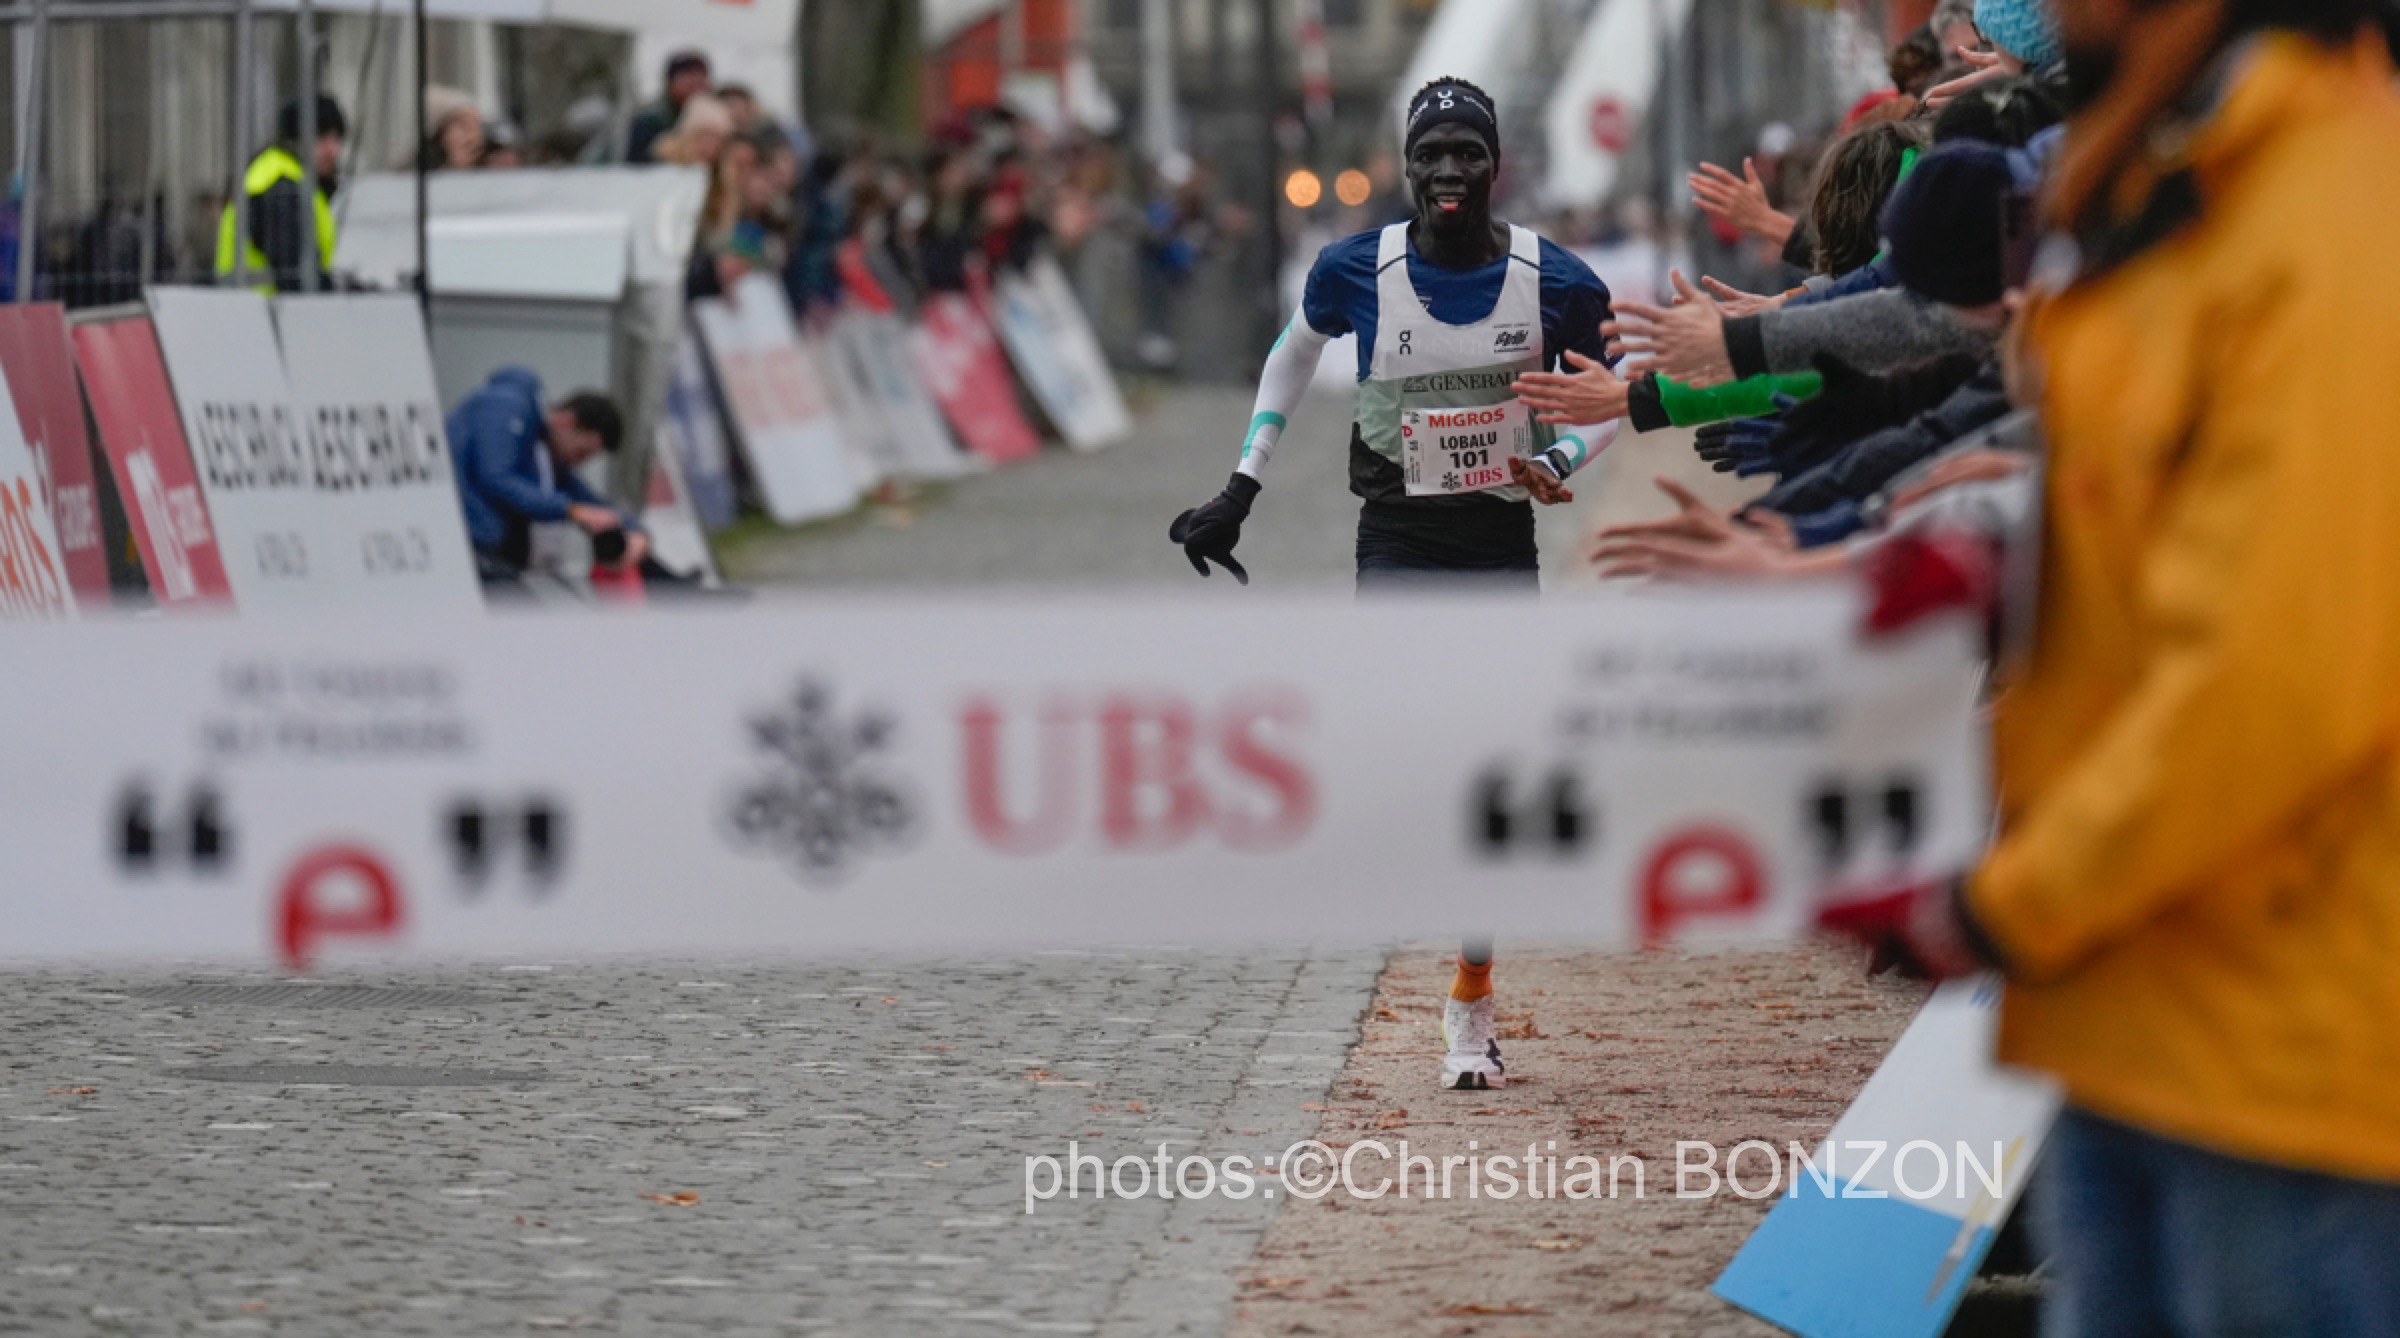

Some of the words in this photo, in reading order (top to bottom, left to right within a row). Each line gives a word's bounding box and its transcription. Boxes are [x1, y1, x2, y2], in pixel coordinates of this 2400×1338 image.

[1428, 408, 1505, 428] MIGROS
[1439, 431, 1497, 450] LOBALU
[1450, 450, 1489, 469] 101
[1464, 468, 1503, 487] UBS
[962, 692, 1318, 856] UBS
